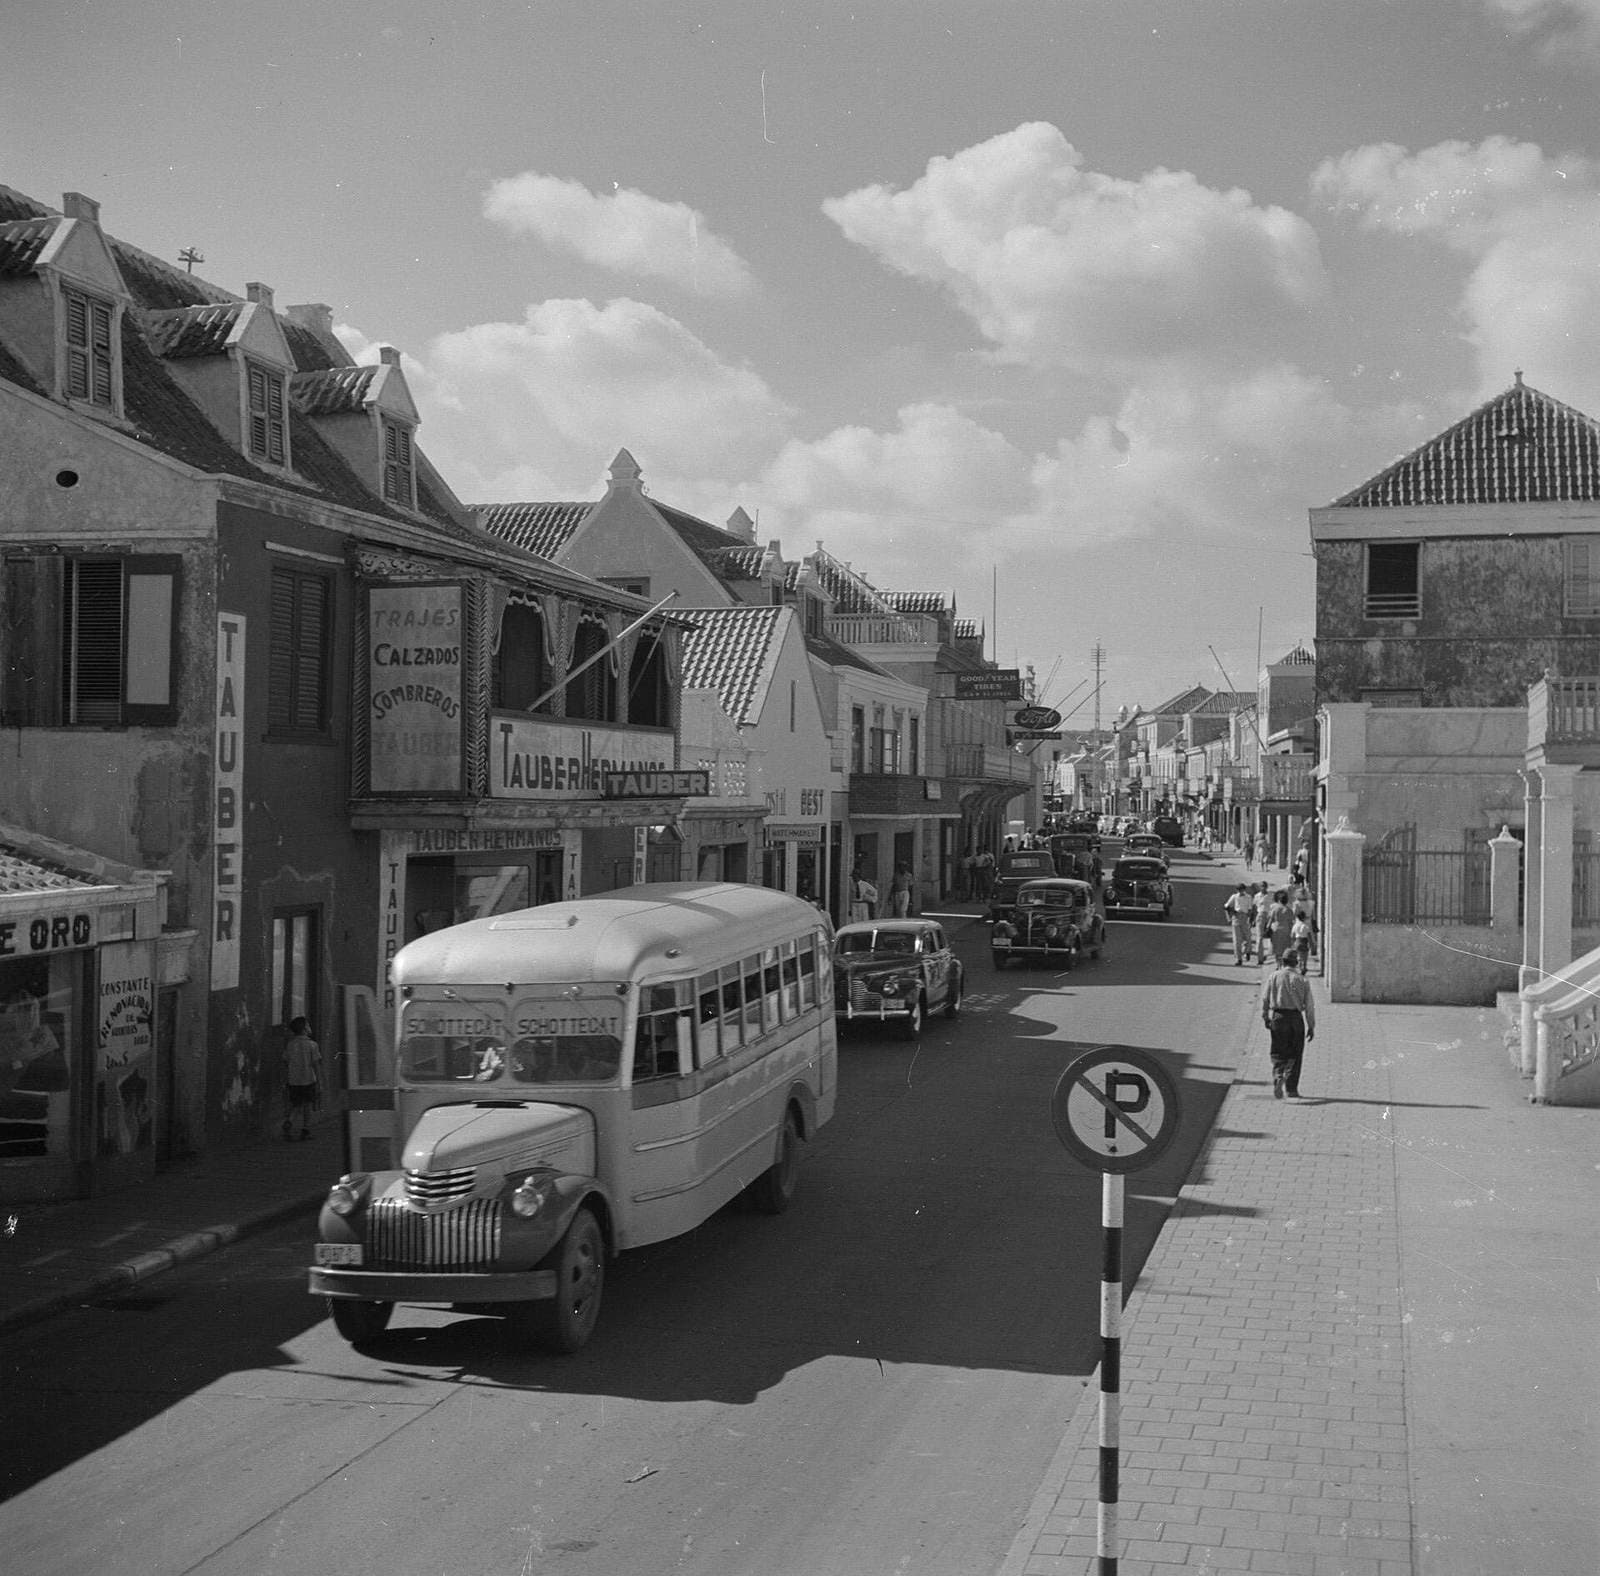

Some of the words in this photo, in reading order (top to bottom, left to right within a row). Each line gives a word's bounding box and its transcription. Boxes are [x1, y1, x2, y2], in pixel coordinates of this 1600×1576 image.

[375, 608, 459, 628] TRAJES
[216, 621, 238, 941] TAUBER
[608, 773, 708, 796] TAUBER
[801, 789, 824, 816] BEST
[415, 830, 478, 852] TAUBER
[483, 829, 561, 850] HERMANOS
[30, 914, 91, 951] ORO
[1104, 1071, 1151, 1139] P
